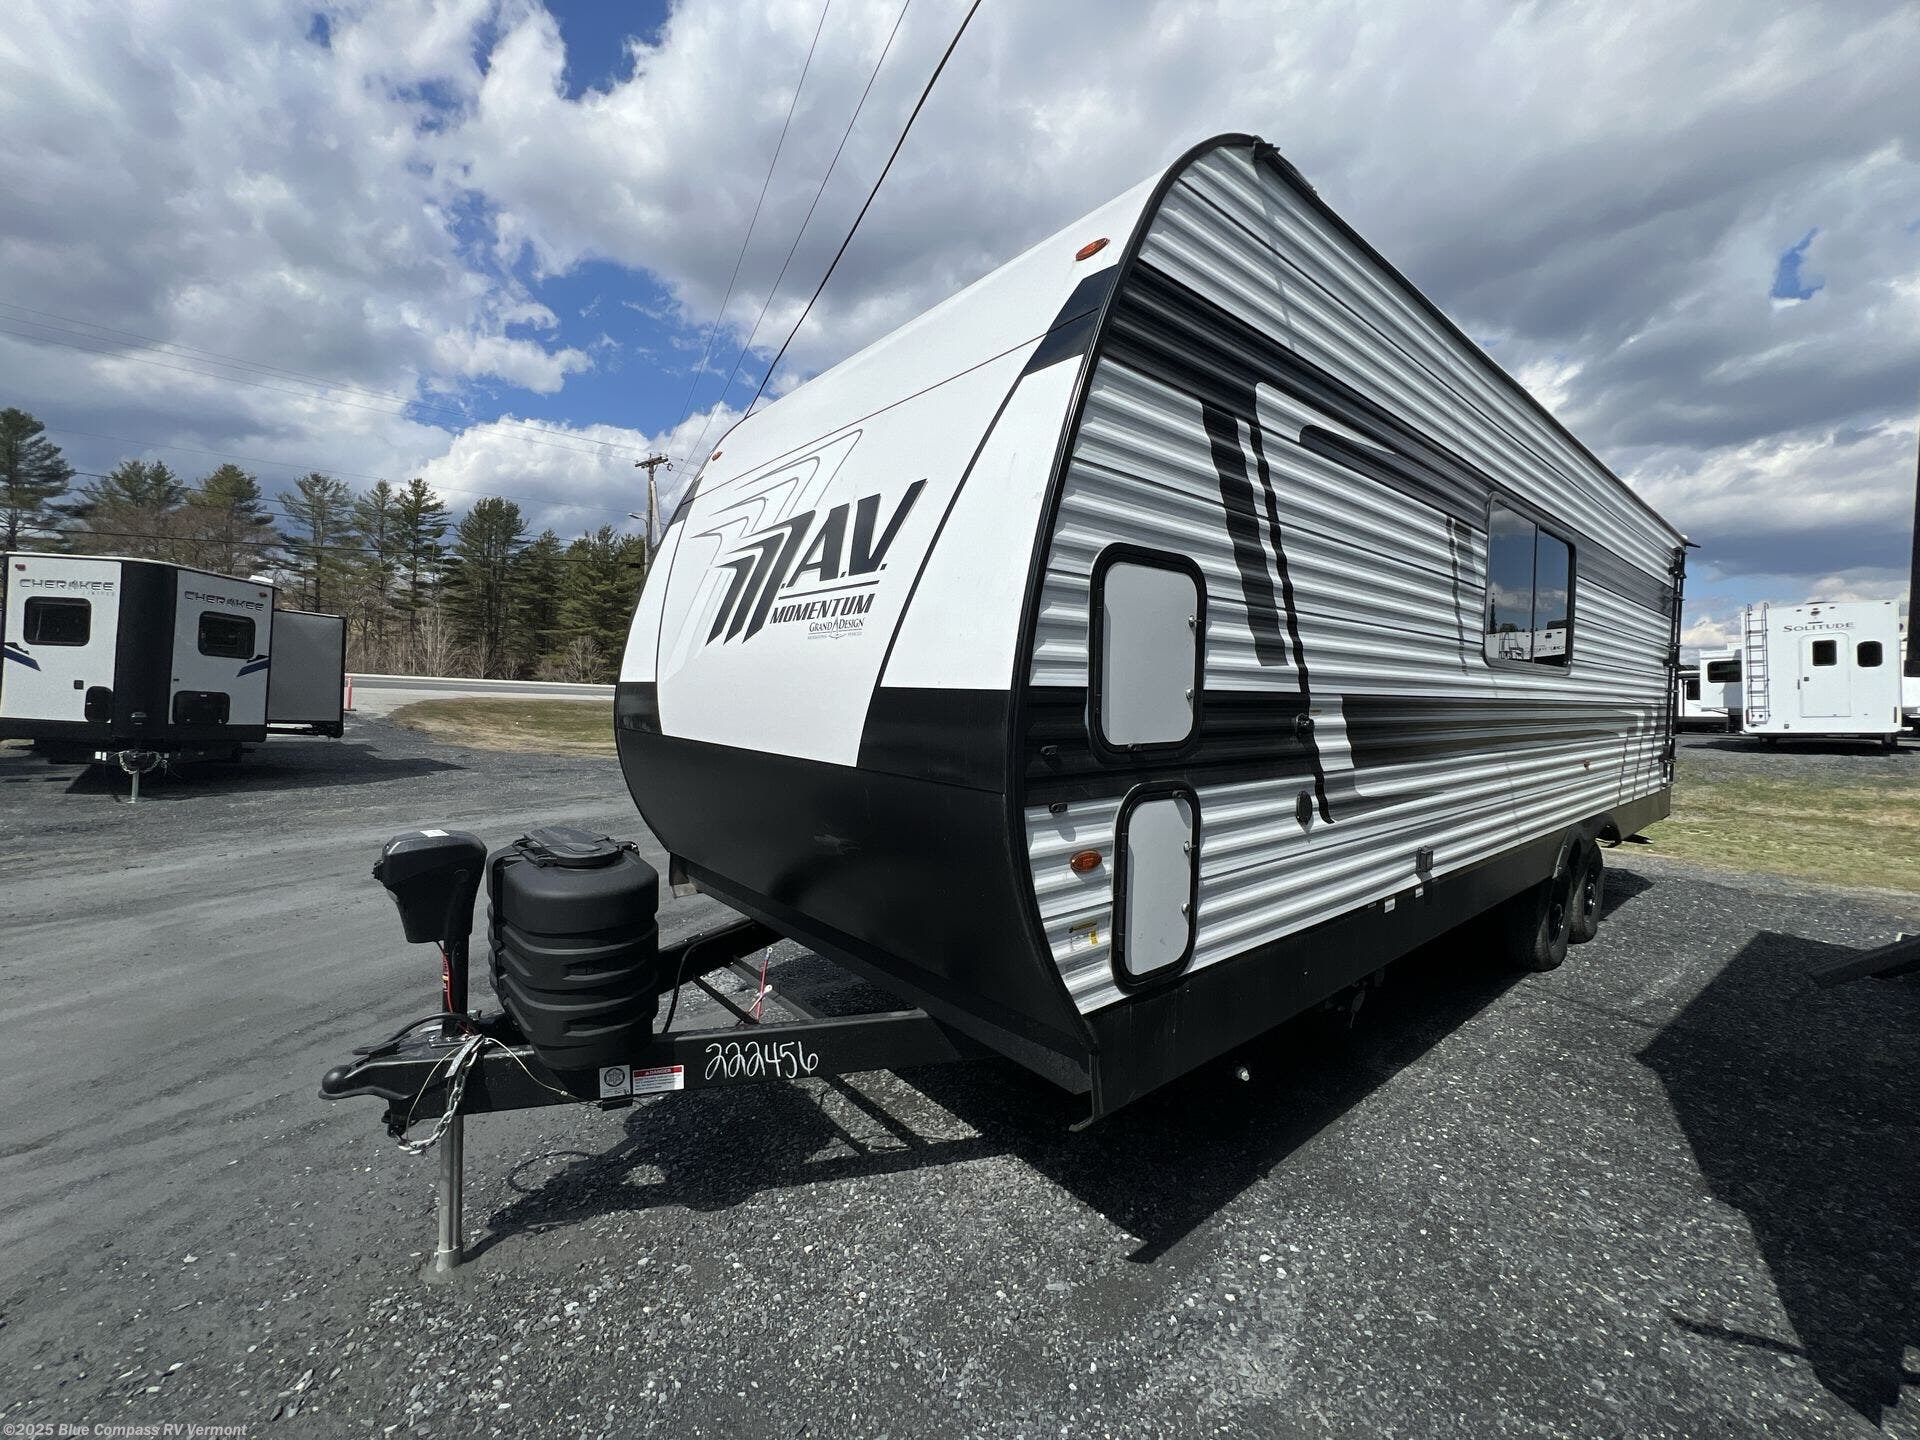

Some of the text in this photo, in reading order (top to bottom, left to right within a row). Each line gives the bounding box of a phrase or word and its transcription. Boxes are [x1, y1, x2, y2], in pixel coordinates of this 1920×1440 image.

[769, 593, 876, 625] MOMENTUM
[809, 619, 864, 632] GRAND DESIGN
[1783, 622, 1856, 633] SOLITUDE
[705, 1041, 819, 1081] 222456
